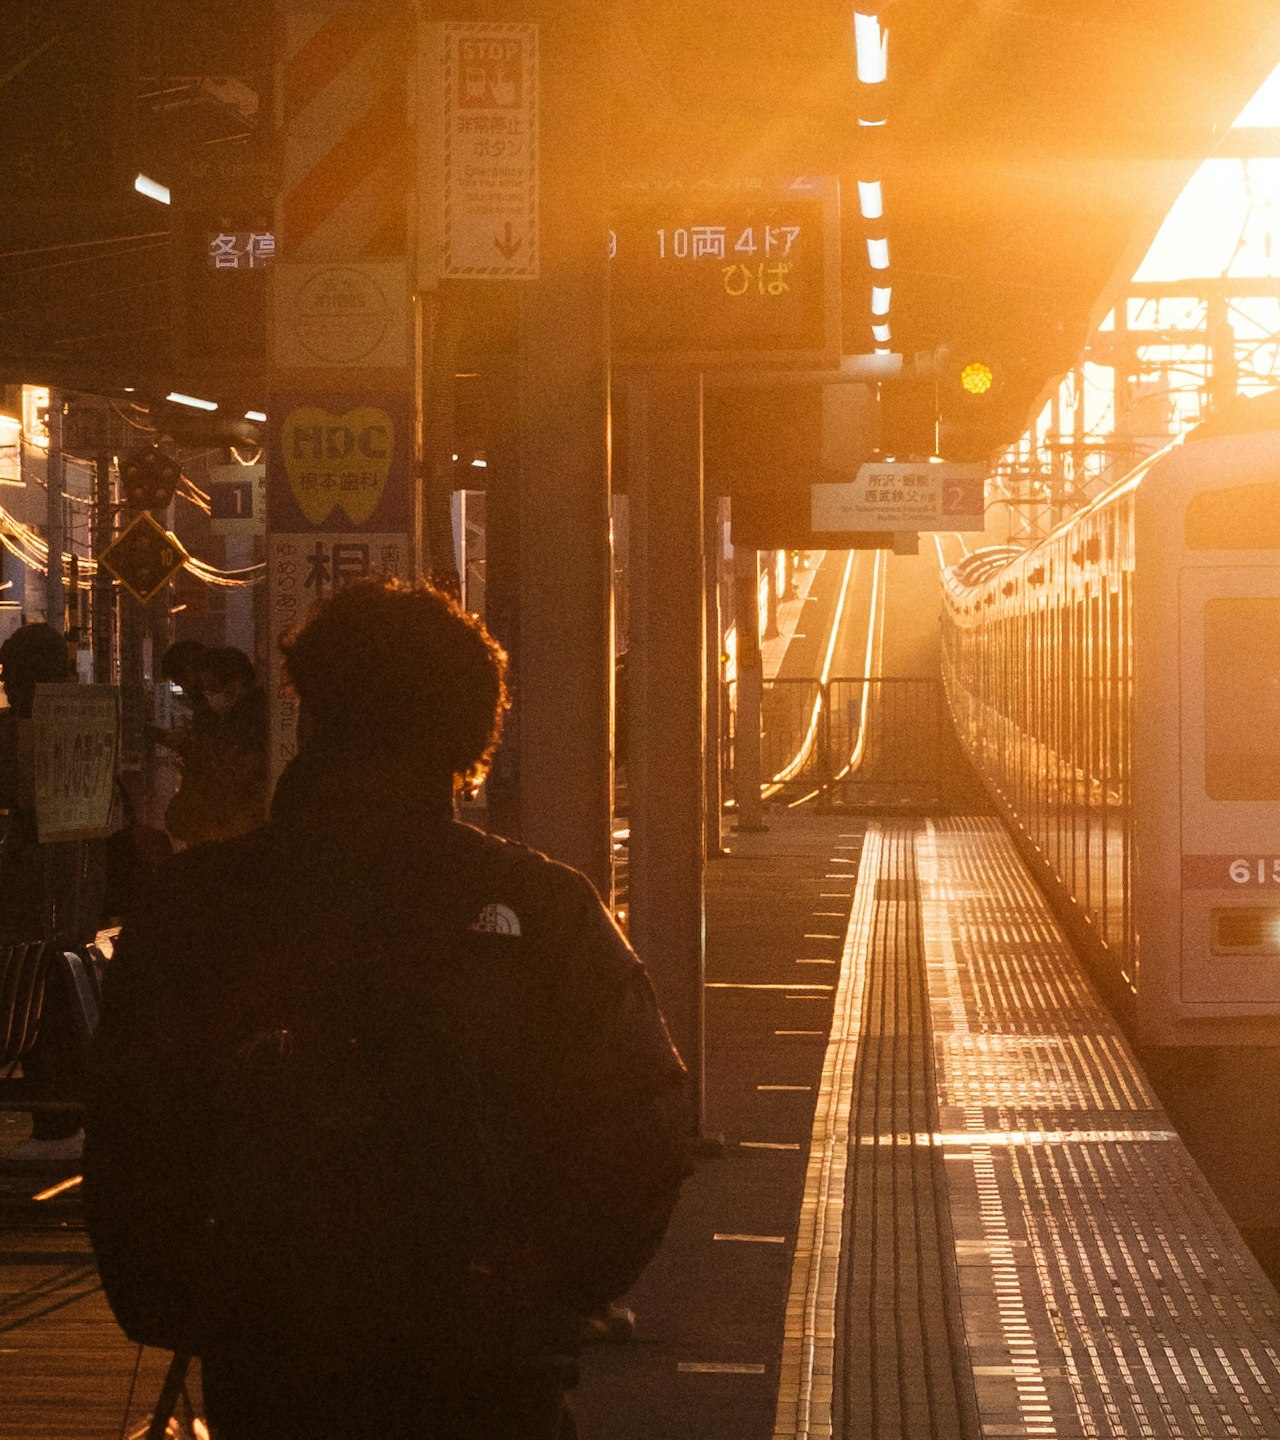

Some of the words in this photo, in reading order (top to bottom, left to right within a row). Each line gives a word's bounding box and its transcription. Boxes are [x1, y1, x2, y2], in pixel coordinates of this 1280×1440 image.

[462, 41, 521, 60] STOP
[456, 116, 524, 136] 非常停止
[473, 139, 523, 157] ボタン
[208, 231, 275, 269] 各停
[656, 225, 727, 259] 10両
[733, 225, 801, 258] 4ドア
[292, 425, 387, 460] HDC
[233, 489, 242, 515] 1
[947, 486, 964, 511] 2
